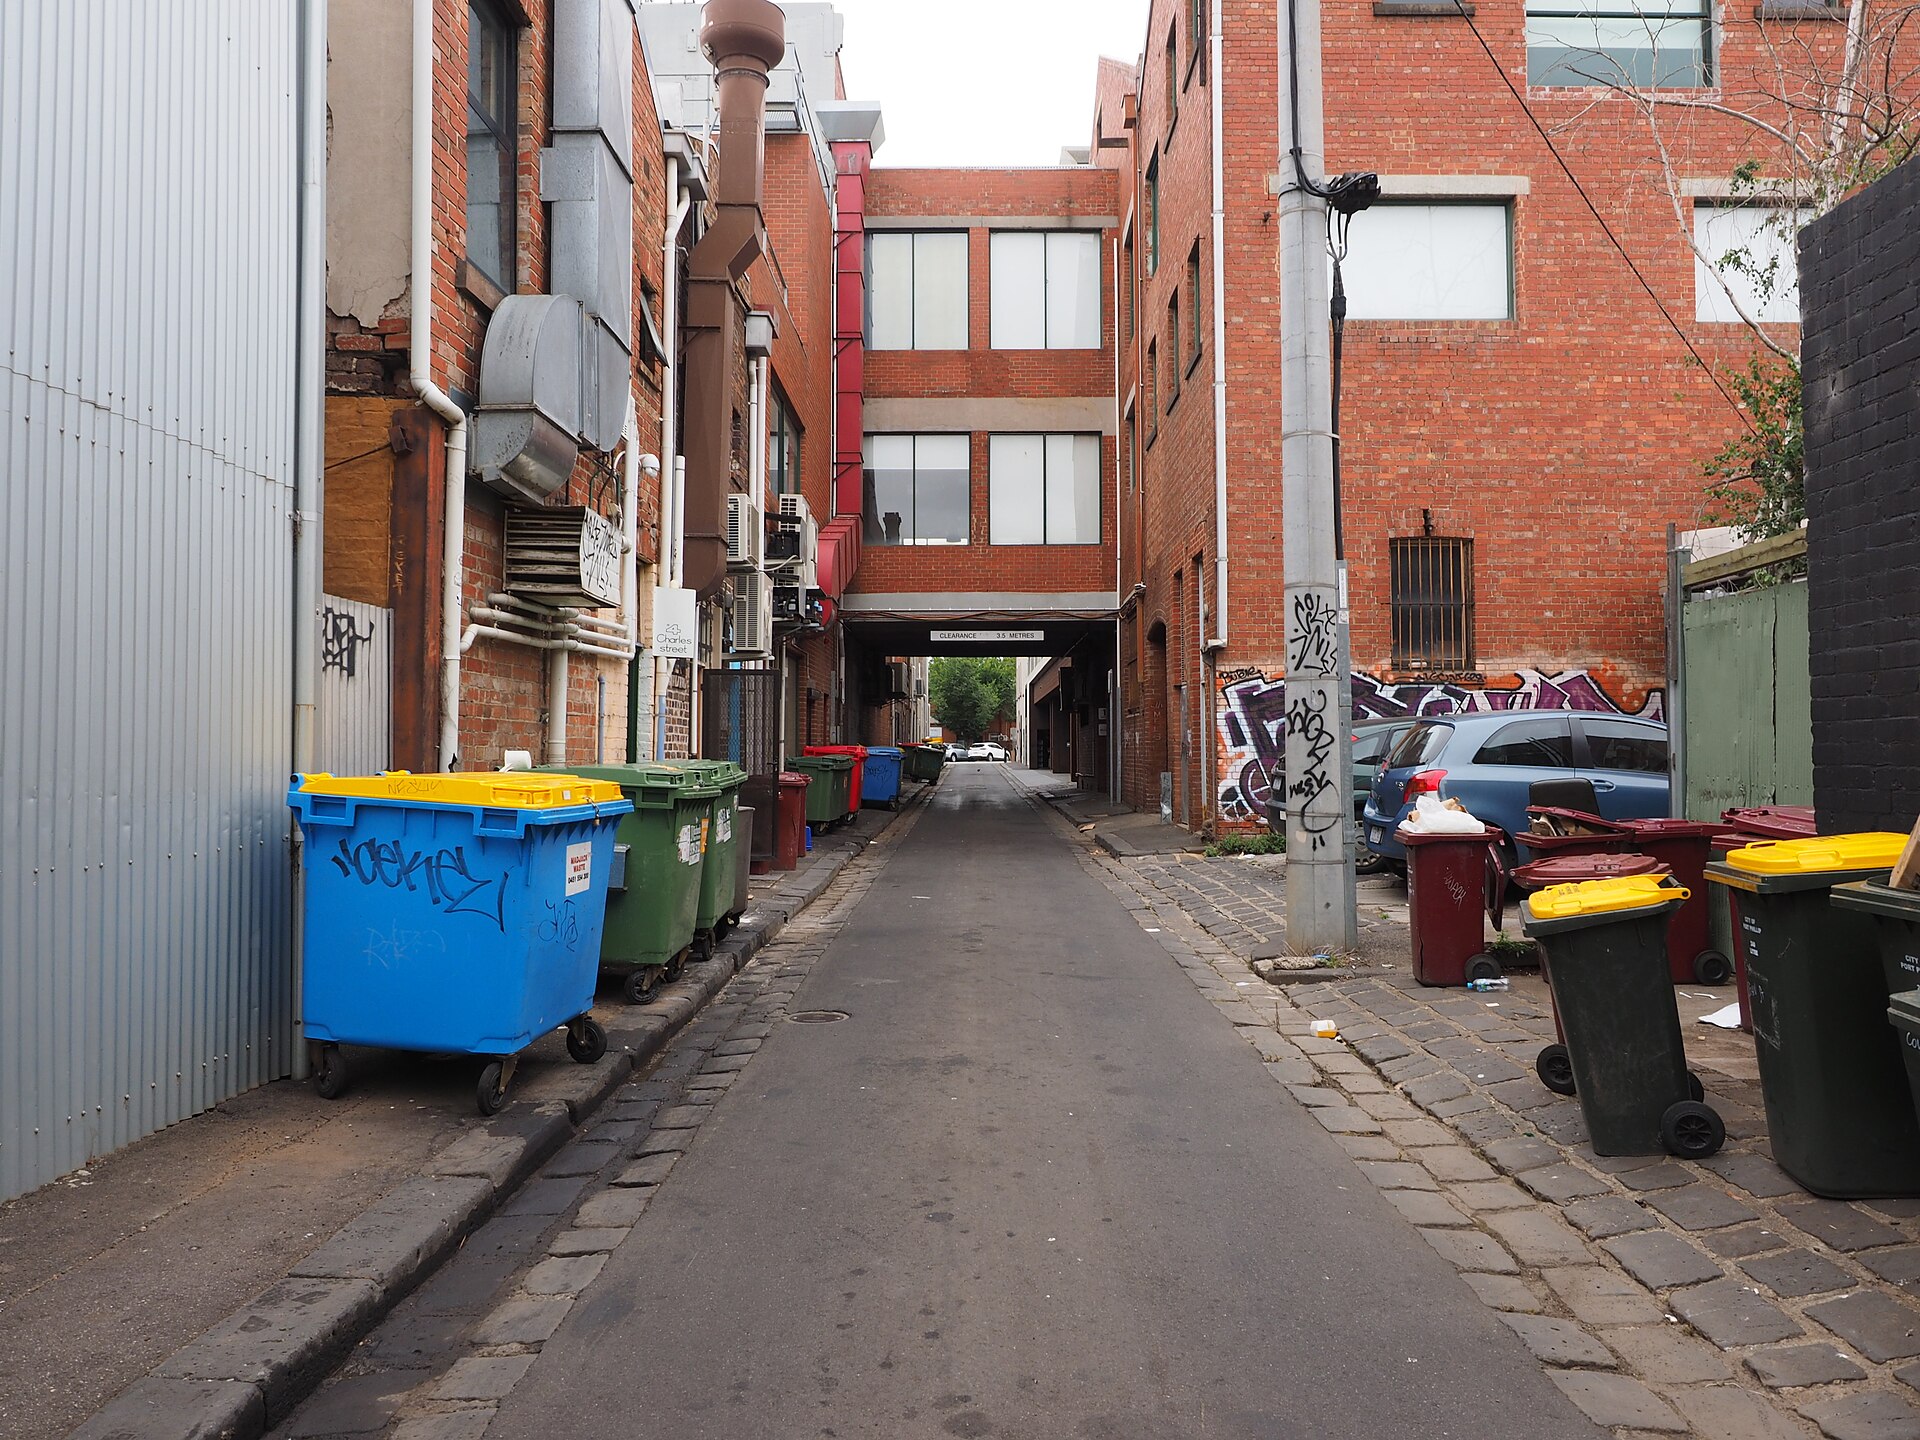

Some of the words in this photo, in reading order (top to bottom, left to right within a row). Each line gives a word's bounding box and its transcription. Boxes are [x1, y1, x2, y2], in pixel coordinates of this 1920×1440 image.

[665, 623, 681, 636] 4
[656, 633, 692, 645] Charles
[659, 643, 688, 654] street
[1905, 954, 1919, 964] CITY
[1900, 961, 1915, 972] PORT
